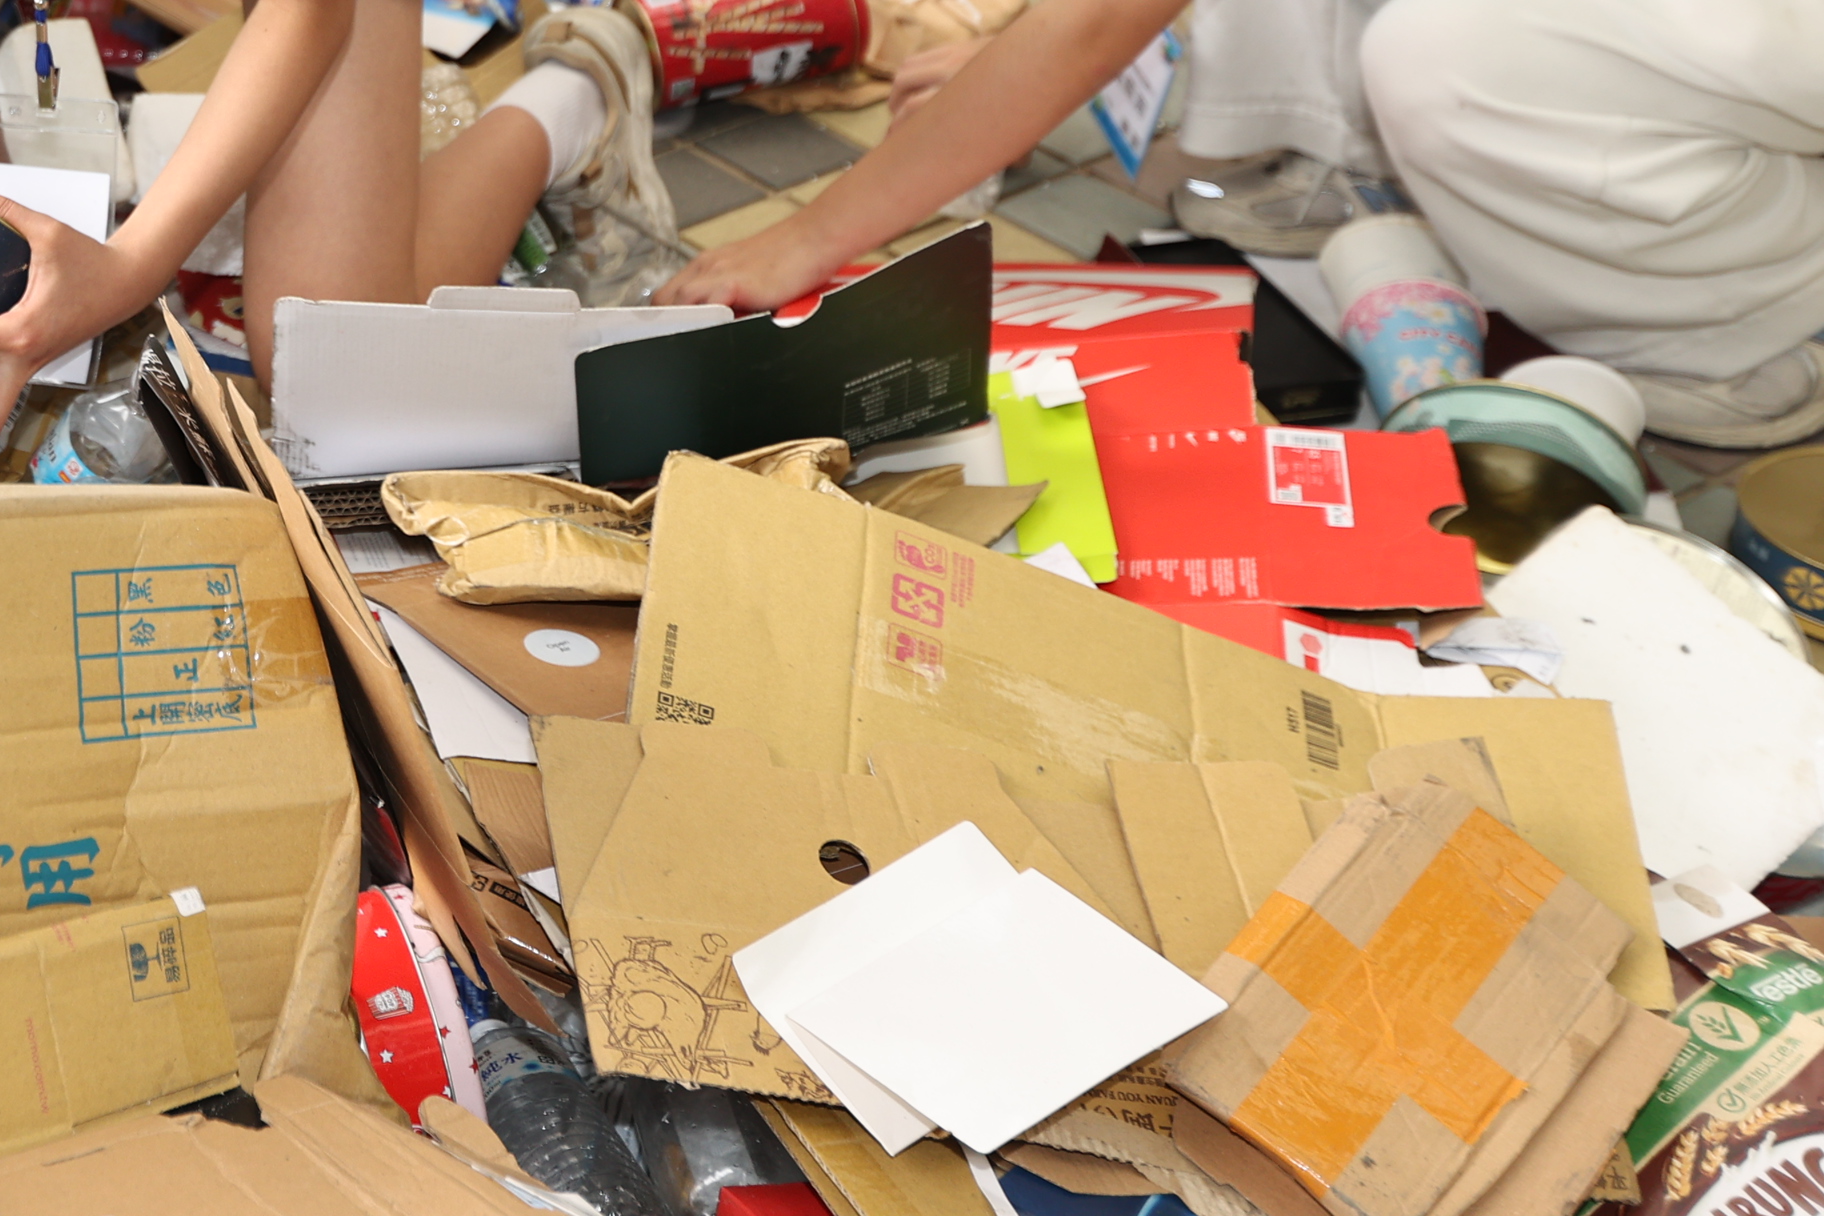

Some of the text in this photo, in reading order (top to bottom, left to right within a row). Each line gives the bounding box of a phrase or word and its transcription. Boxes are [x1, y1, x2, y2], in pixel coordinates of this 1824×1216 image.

[159, 926, 181, 984] 易碎品
[1751, 962, 1824, 1003] estlé
[1118, 1090, 1145, 1104] YOU
[1657, 1051, 1720, 1104] Guaranteed
